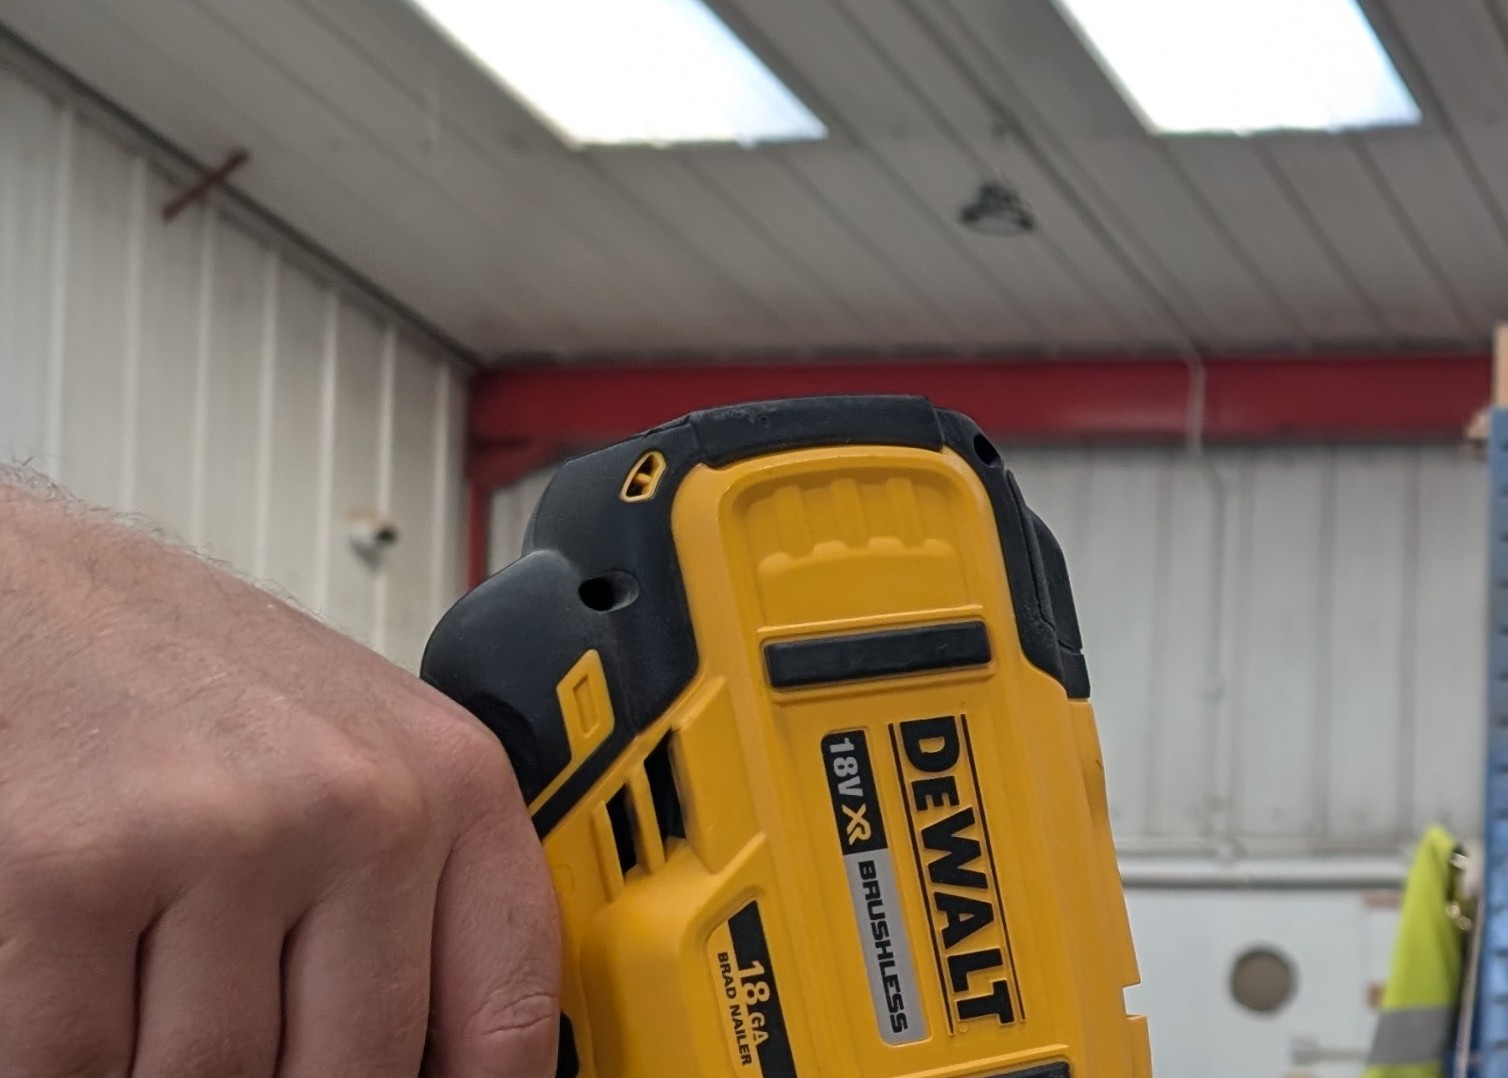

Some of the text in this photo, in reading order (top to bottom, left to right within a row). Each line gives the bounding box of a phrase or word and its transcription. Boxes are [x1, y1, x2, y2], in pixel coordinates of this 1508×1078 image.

[830, 737, 871, 845] 18V XR
[899, 716, 1015, 1024] DEWALT
[717, 951, 752, 1066] BRAD NAILER
[858, 860, 908, 1033] BRUSHLESS
